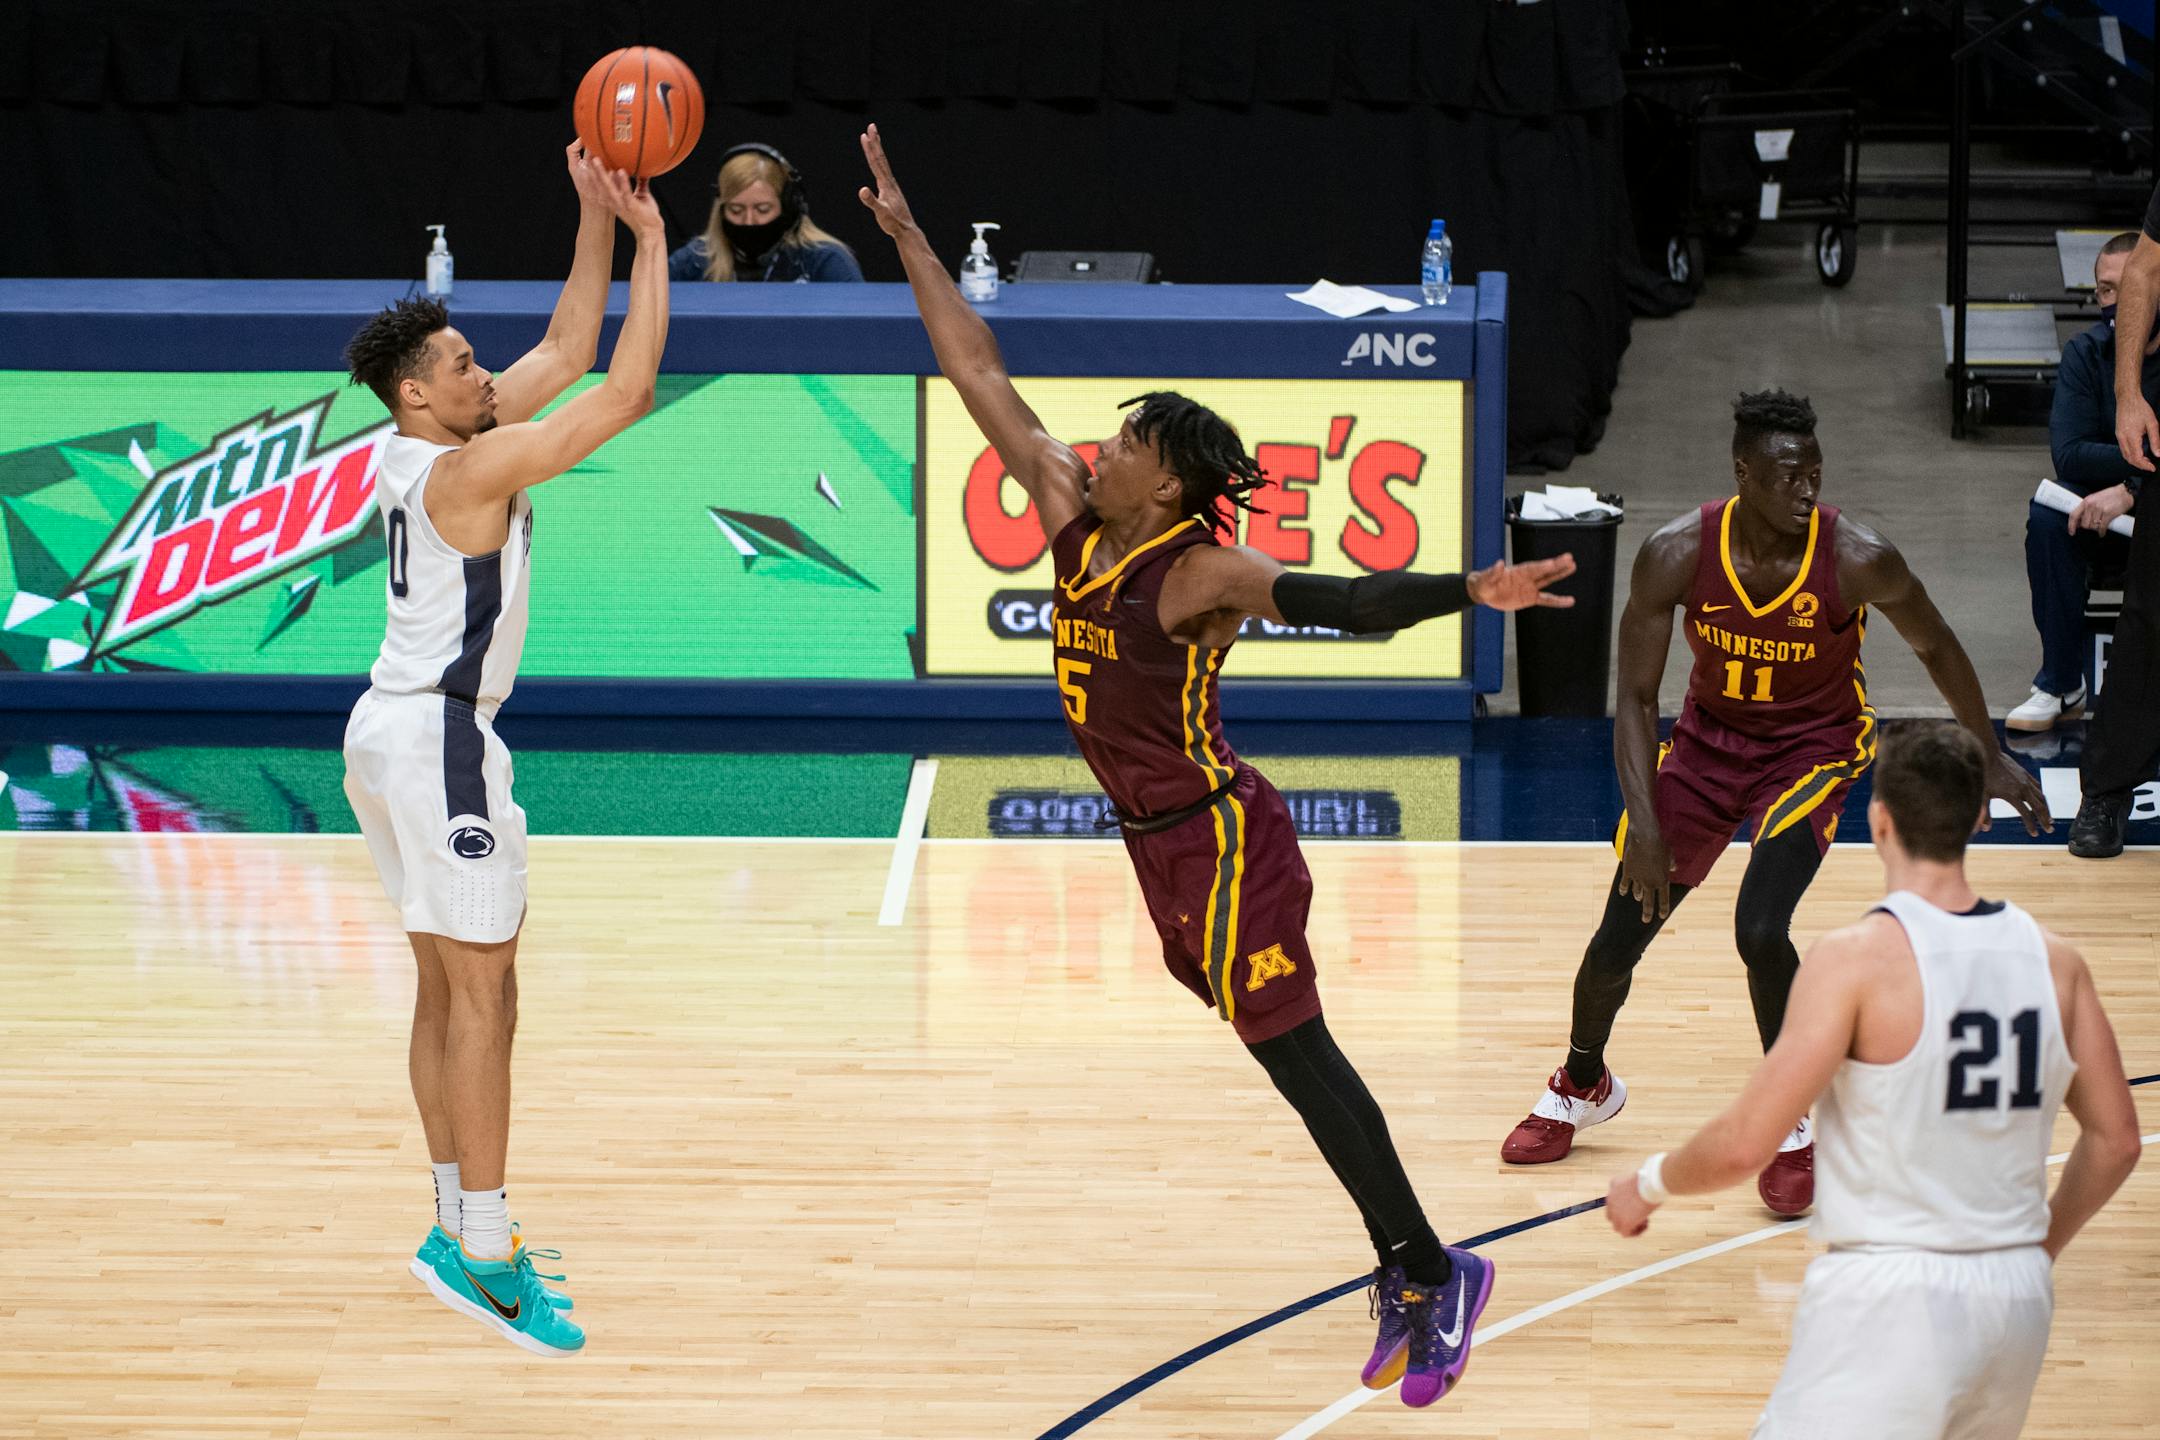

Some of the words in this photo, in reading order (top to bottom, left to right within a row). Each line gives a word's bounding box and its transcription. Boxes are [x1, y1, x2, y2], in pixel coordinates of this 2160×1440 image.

[1341, 332, 1437, 367] ANC
[121, 424, 303, 552] Mtn
[388, 506, 409, 599] 0
[1694, 619, 1817, 662] MINNESOTA
[1057, 656, 1092, 725] 5
[1722, 659, 1774, 702] 11
[1245, 942, 1297, 992] M
[1944, 1007, 2042, 1112] 21
